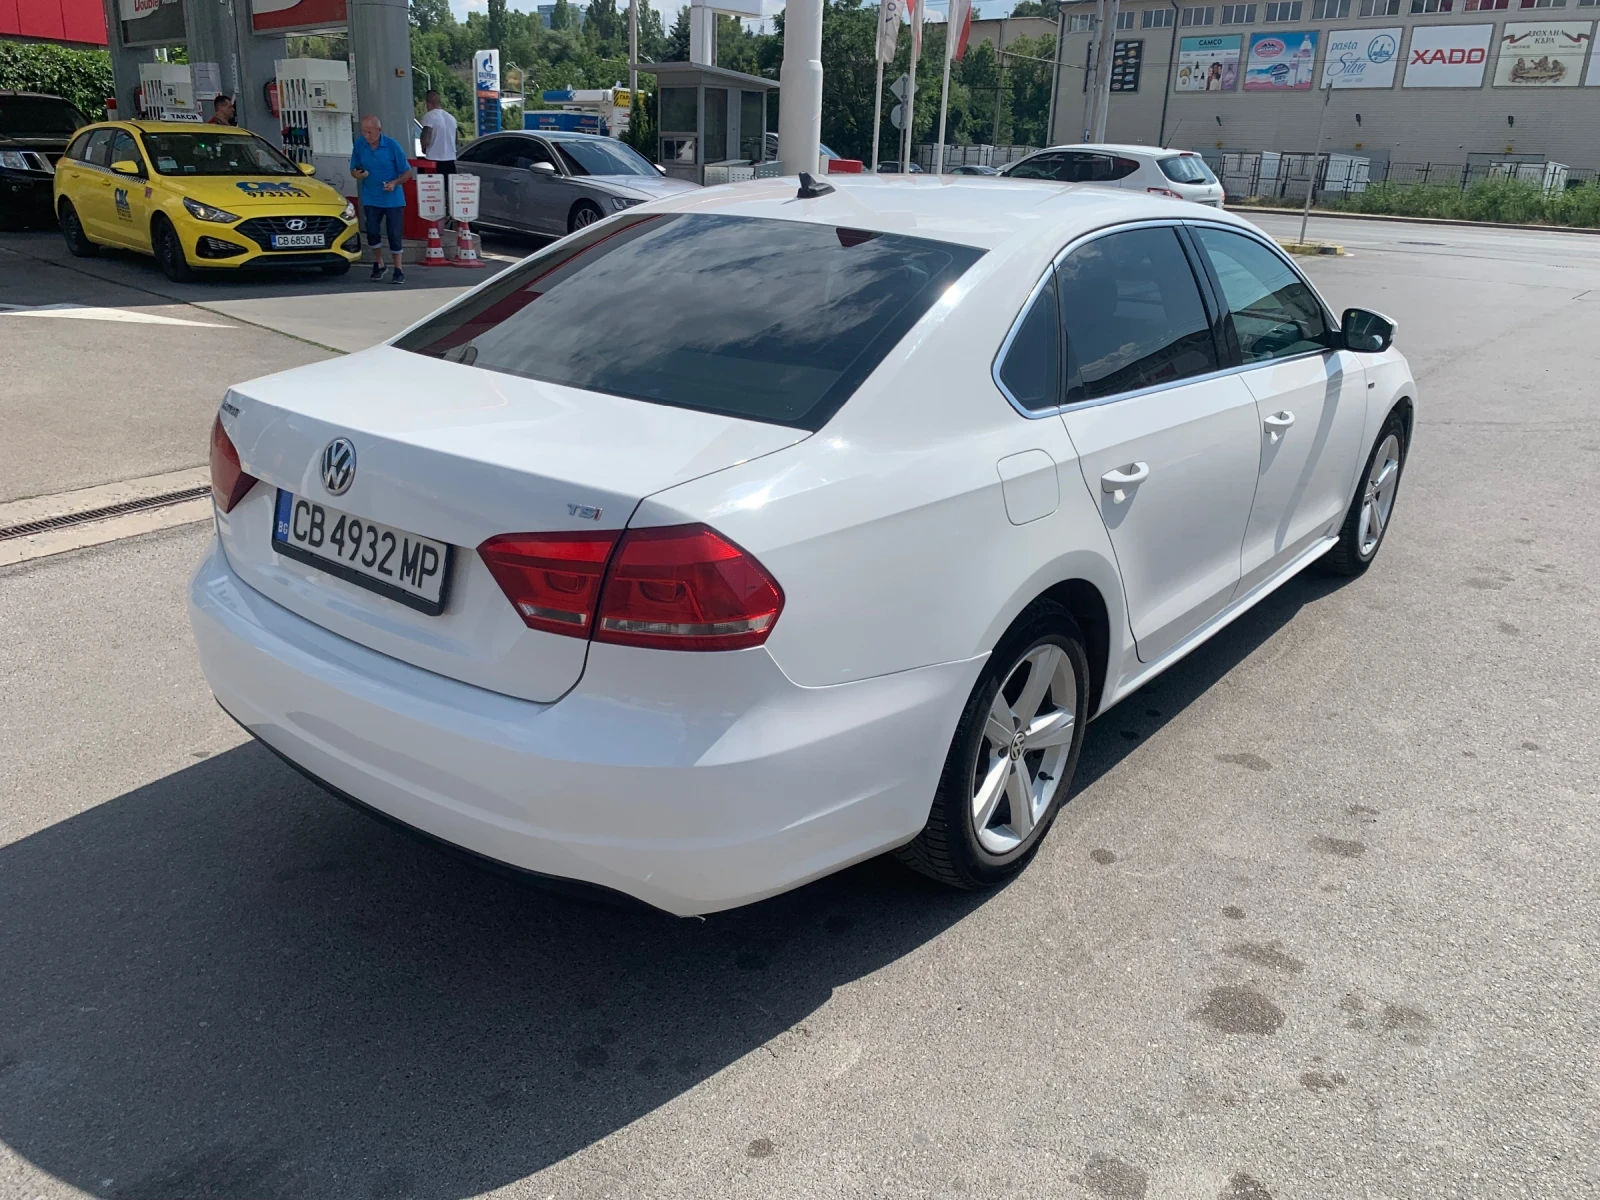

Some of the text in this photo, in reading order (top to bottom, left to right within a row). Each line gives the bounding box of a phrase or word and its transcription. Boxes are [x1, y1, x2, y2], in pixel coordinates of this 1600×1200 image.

[1330, 41, 1358, 52] pasta
[1326, 52, 1367, 76] Silva
[1410, 48, 1486, 65] XADO
[277, 236, 289, 245] CB
[290, 235, 311, 245] 6850
[312, 235, 324, 244] AE
[277, 500, 440, 590] BG CB 4932 MP
